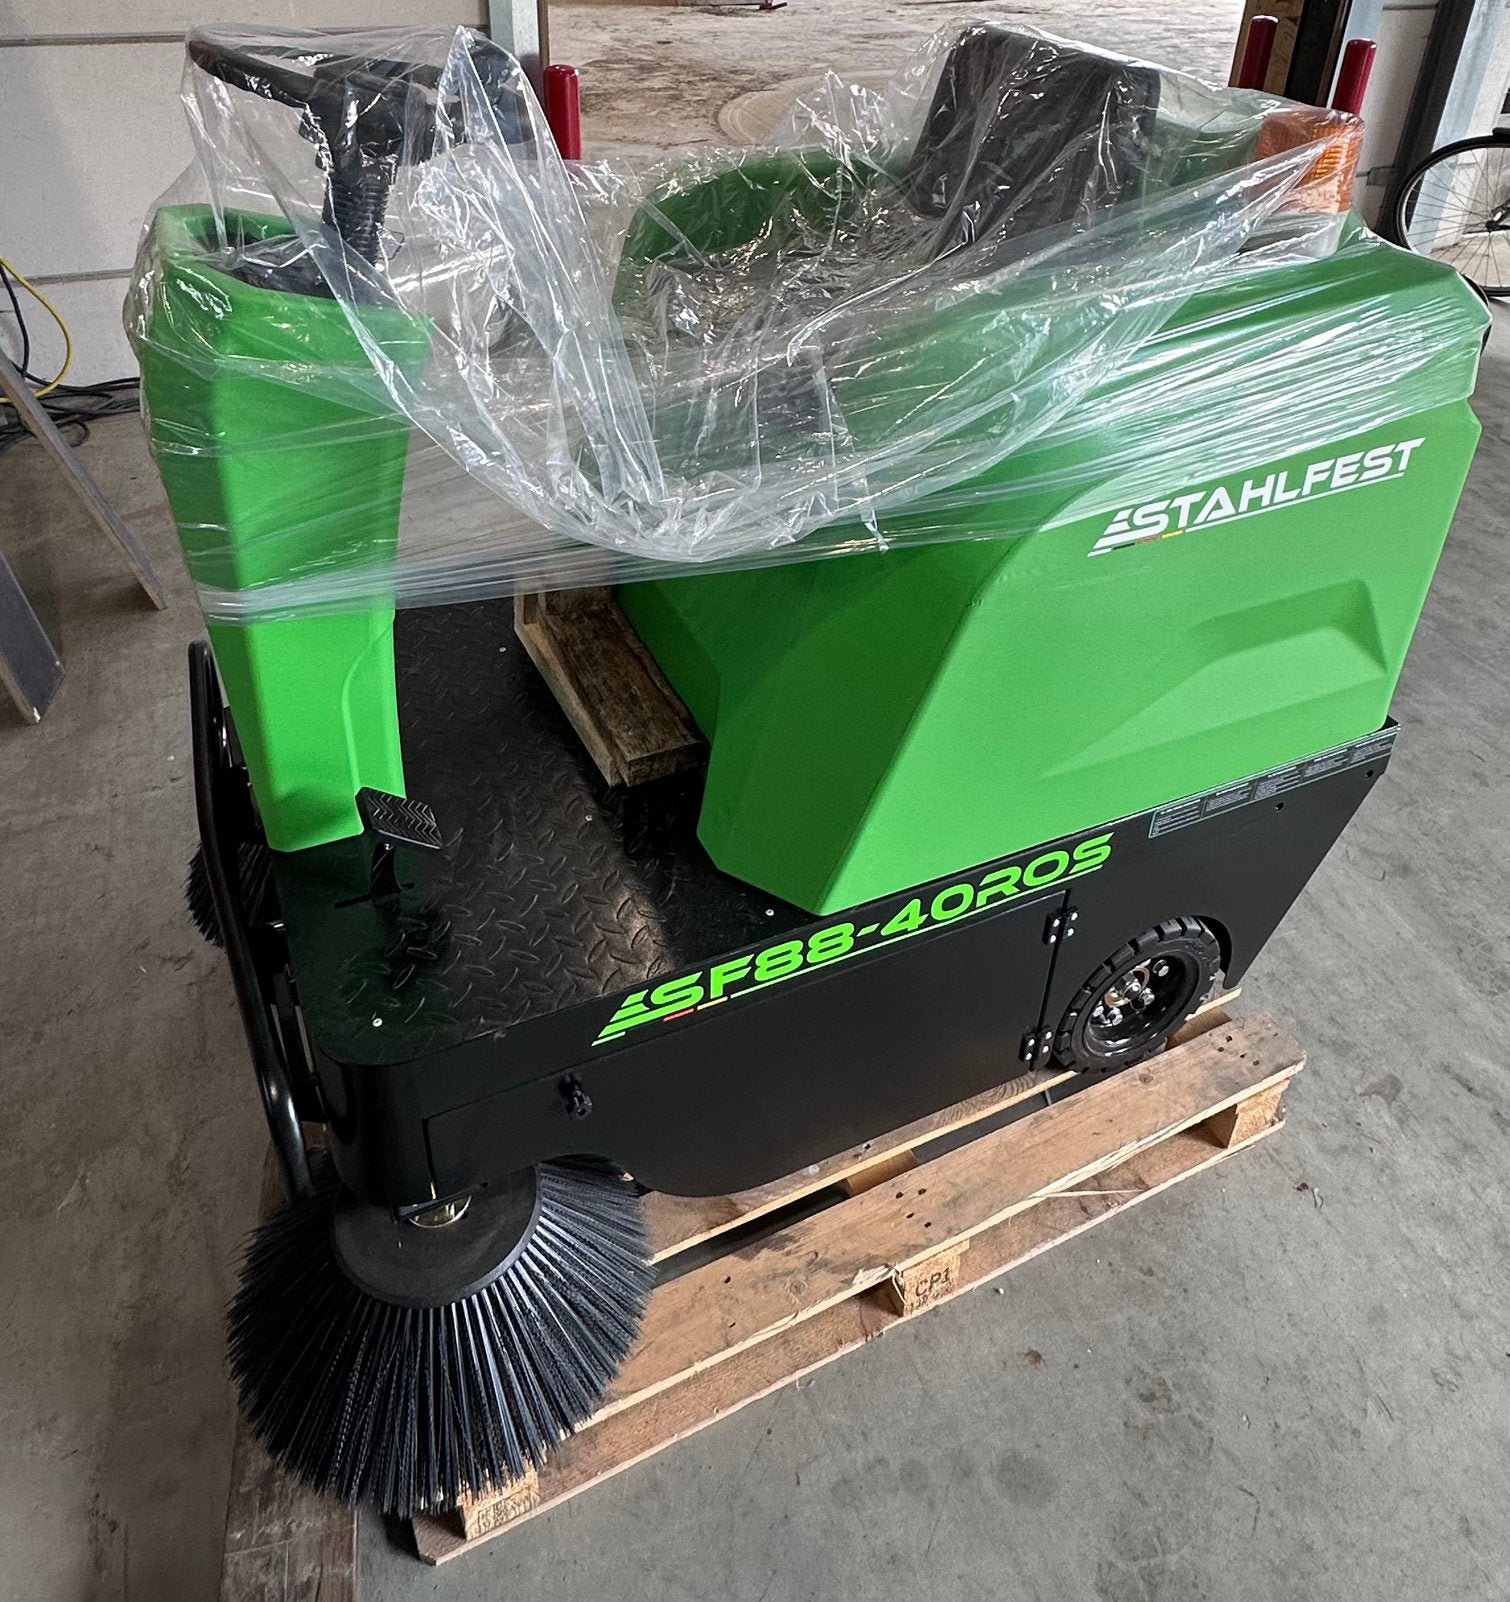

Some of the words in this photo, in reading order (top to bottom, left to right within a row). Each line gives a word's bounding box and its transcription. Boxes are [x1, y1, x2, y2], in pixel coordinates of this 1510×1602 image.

[1091, 437, 1426, 550] STAHLFEST
[597, 832, 1115, 1037] SF88-40ROS
[915, 1267, 950, 1297] CP1
